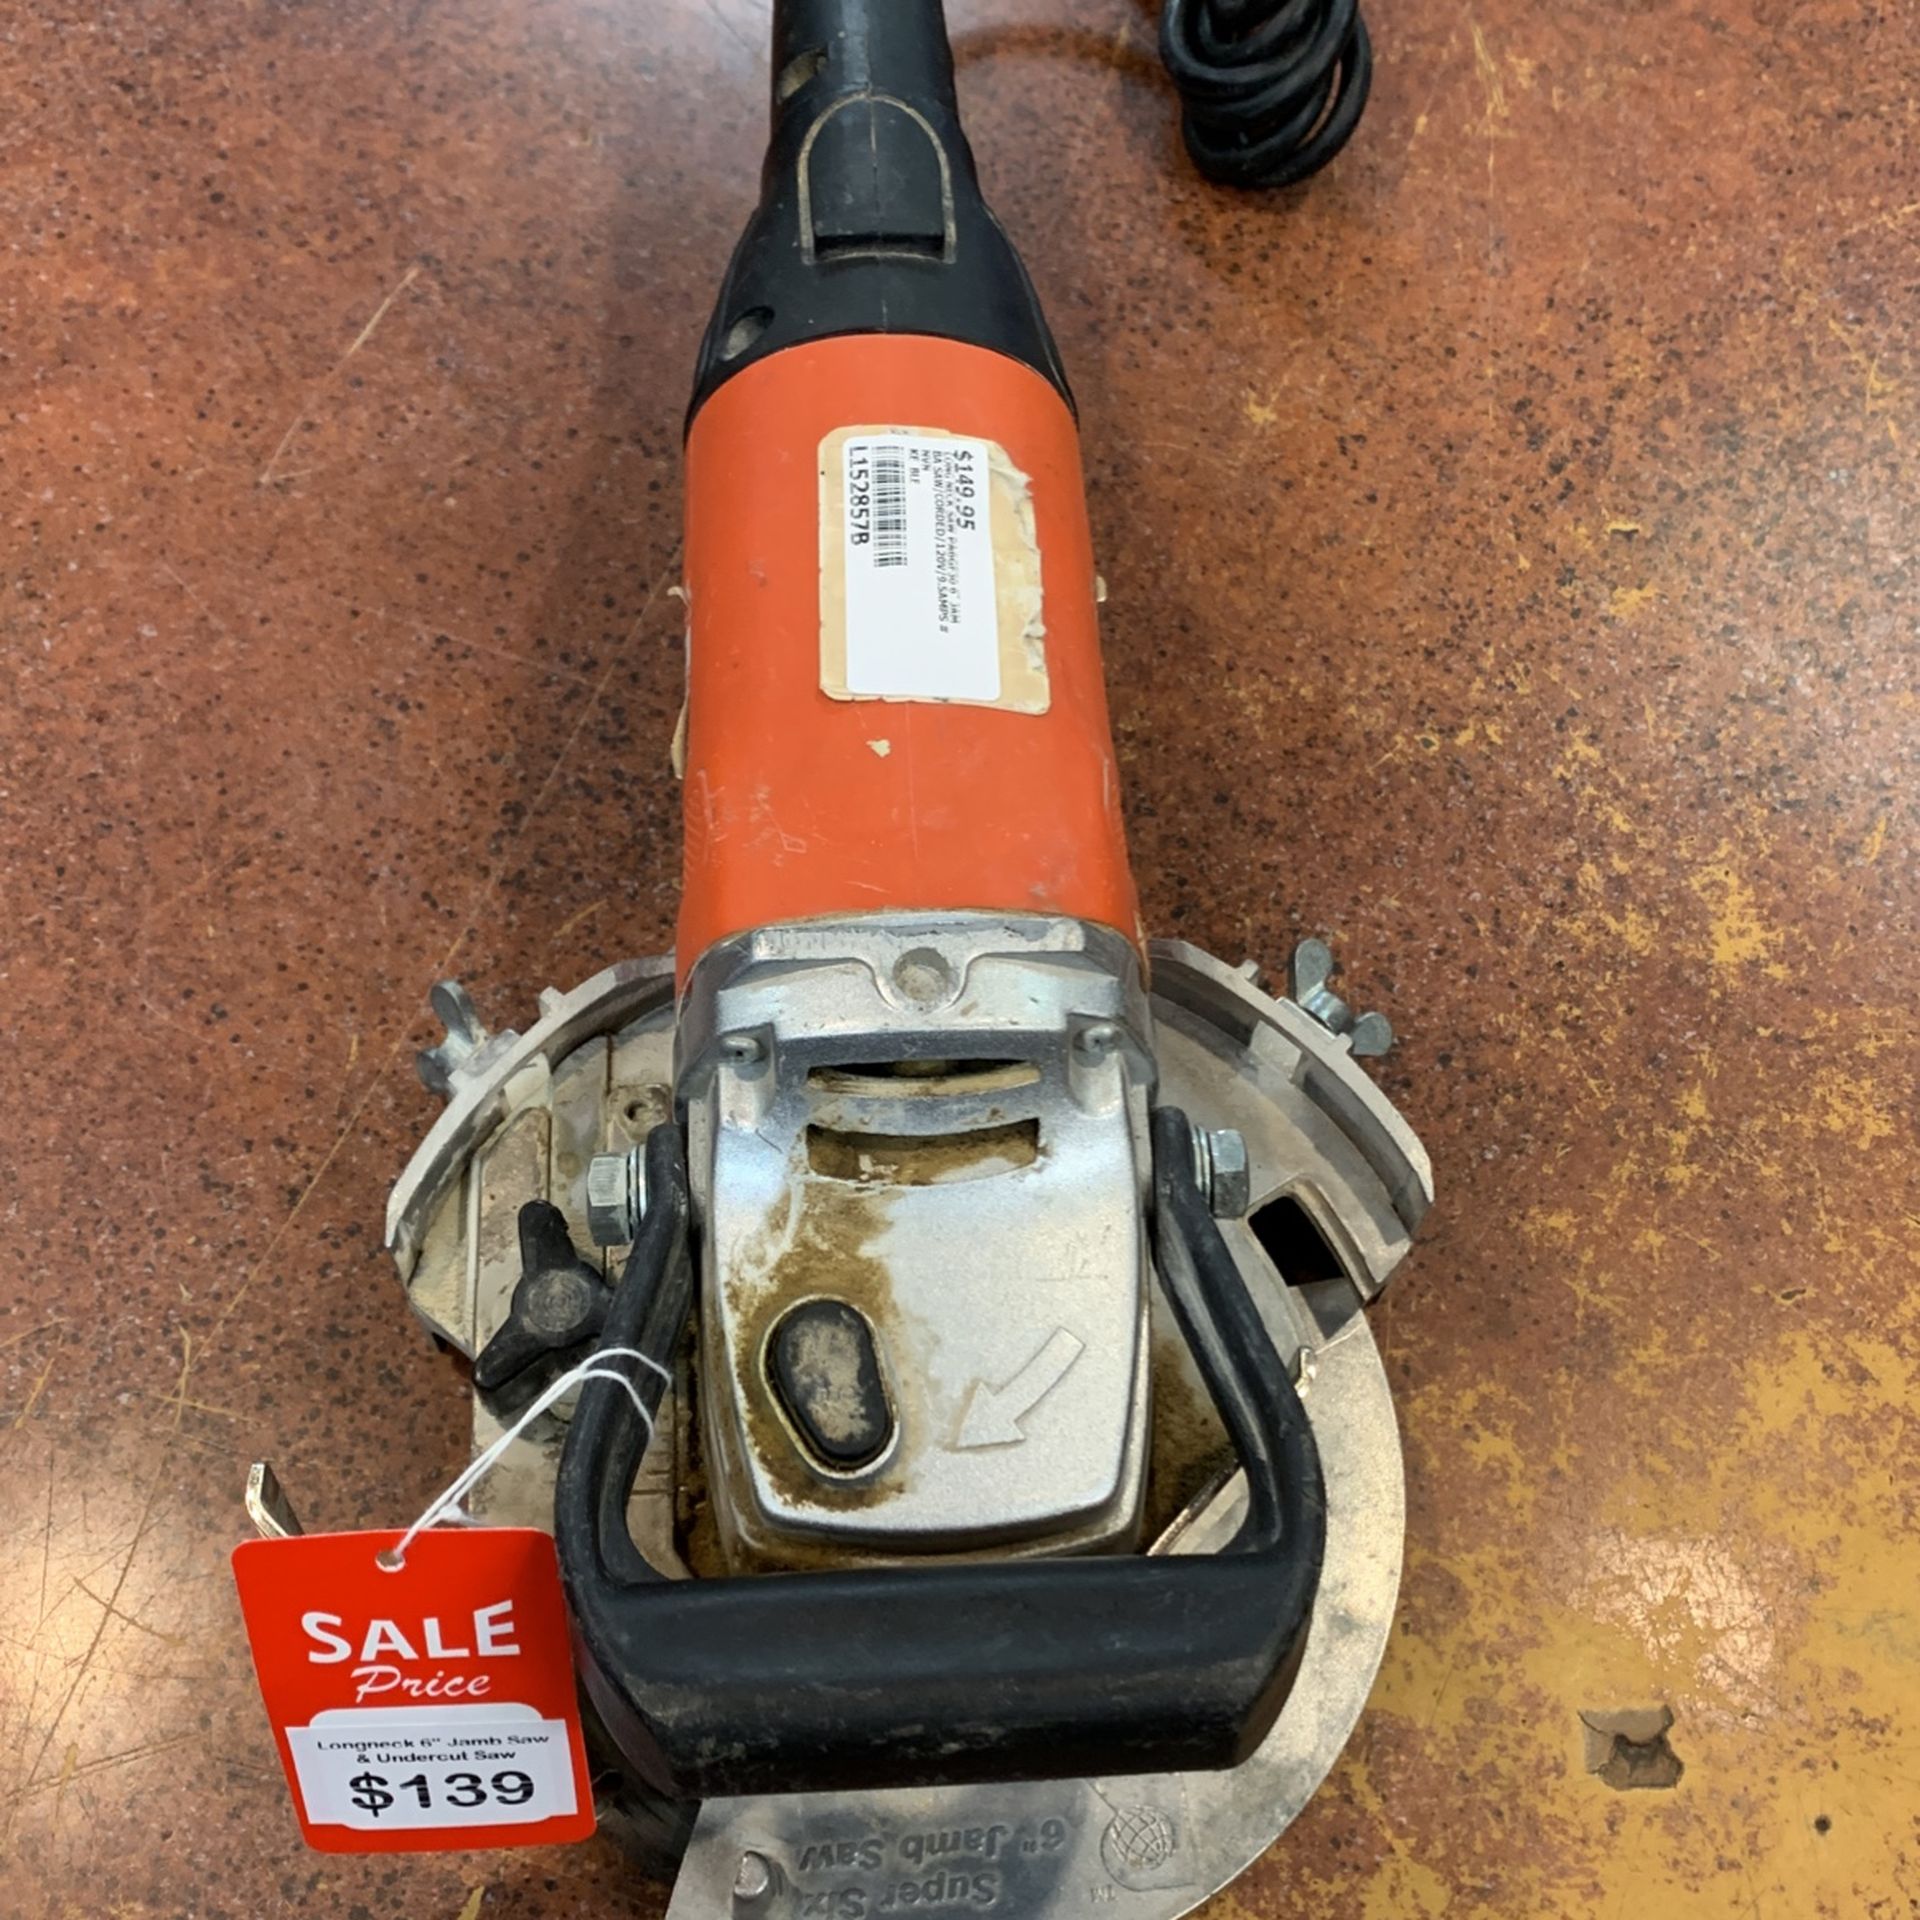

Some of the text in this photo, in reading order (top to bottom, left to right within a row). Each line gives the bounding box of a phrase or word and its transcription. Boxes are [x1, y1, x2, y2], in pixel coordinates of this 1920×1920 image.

[849, 445, 870, 546] L152857B
[953, 450, 976, 530] $149.95
[932, 450, 943, 464] BA
[940, 624, 949, 634] #
[947, 511, 956, 534] SAW
[950, 602, 960, 624] JAM
[301, 1600, 520, 1664] SALE
[350, 1665, 491, 1703] Price
[316, 1734, 550, 1752] Longneck 6" Jamb Saw
[356, 1749, 517, 1764] & Undercut Saw
[349, 1771, 535, 1818] $139
[799, 1818, 1067, 1873] 6" Jamb Saw
[803, 1872, 998, 1920] Super Six
